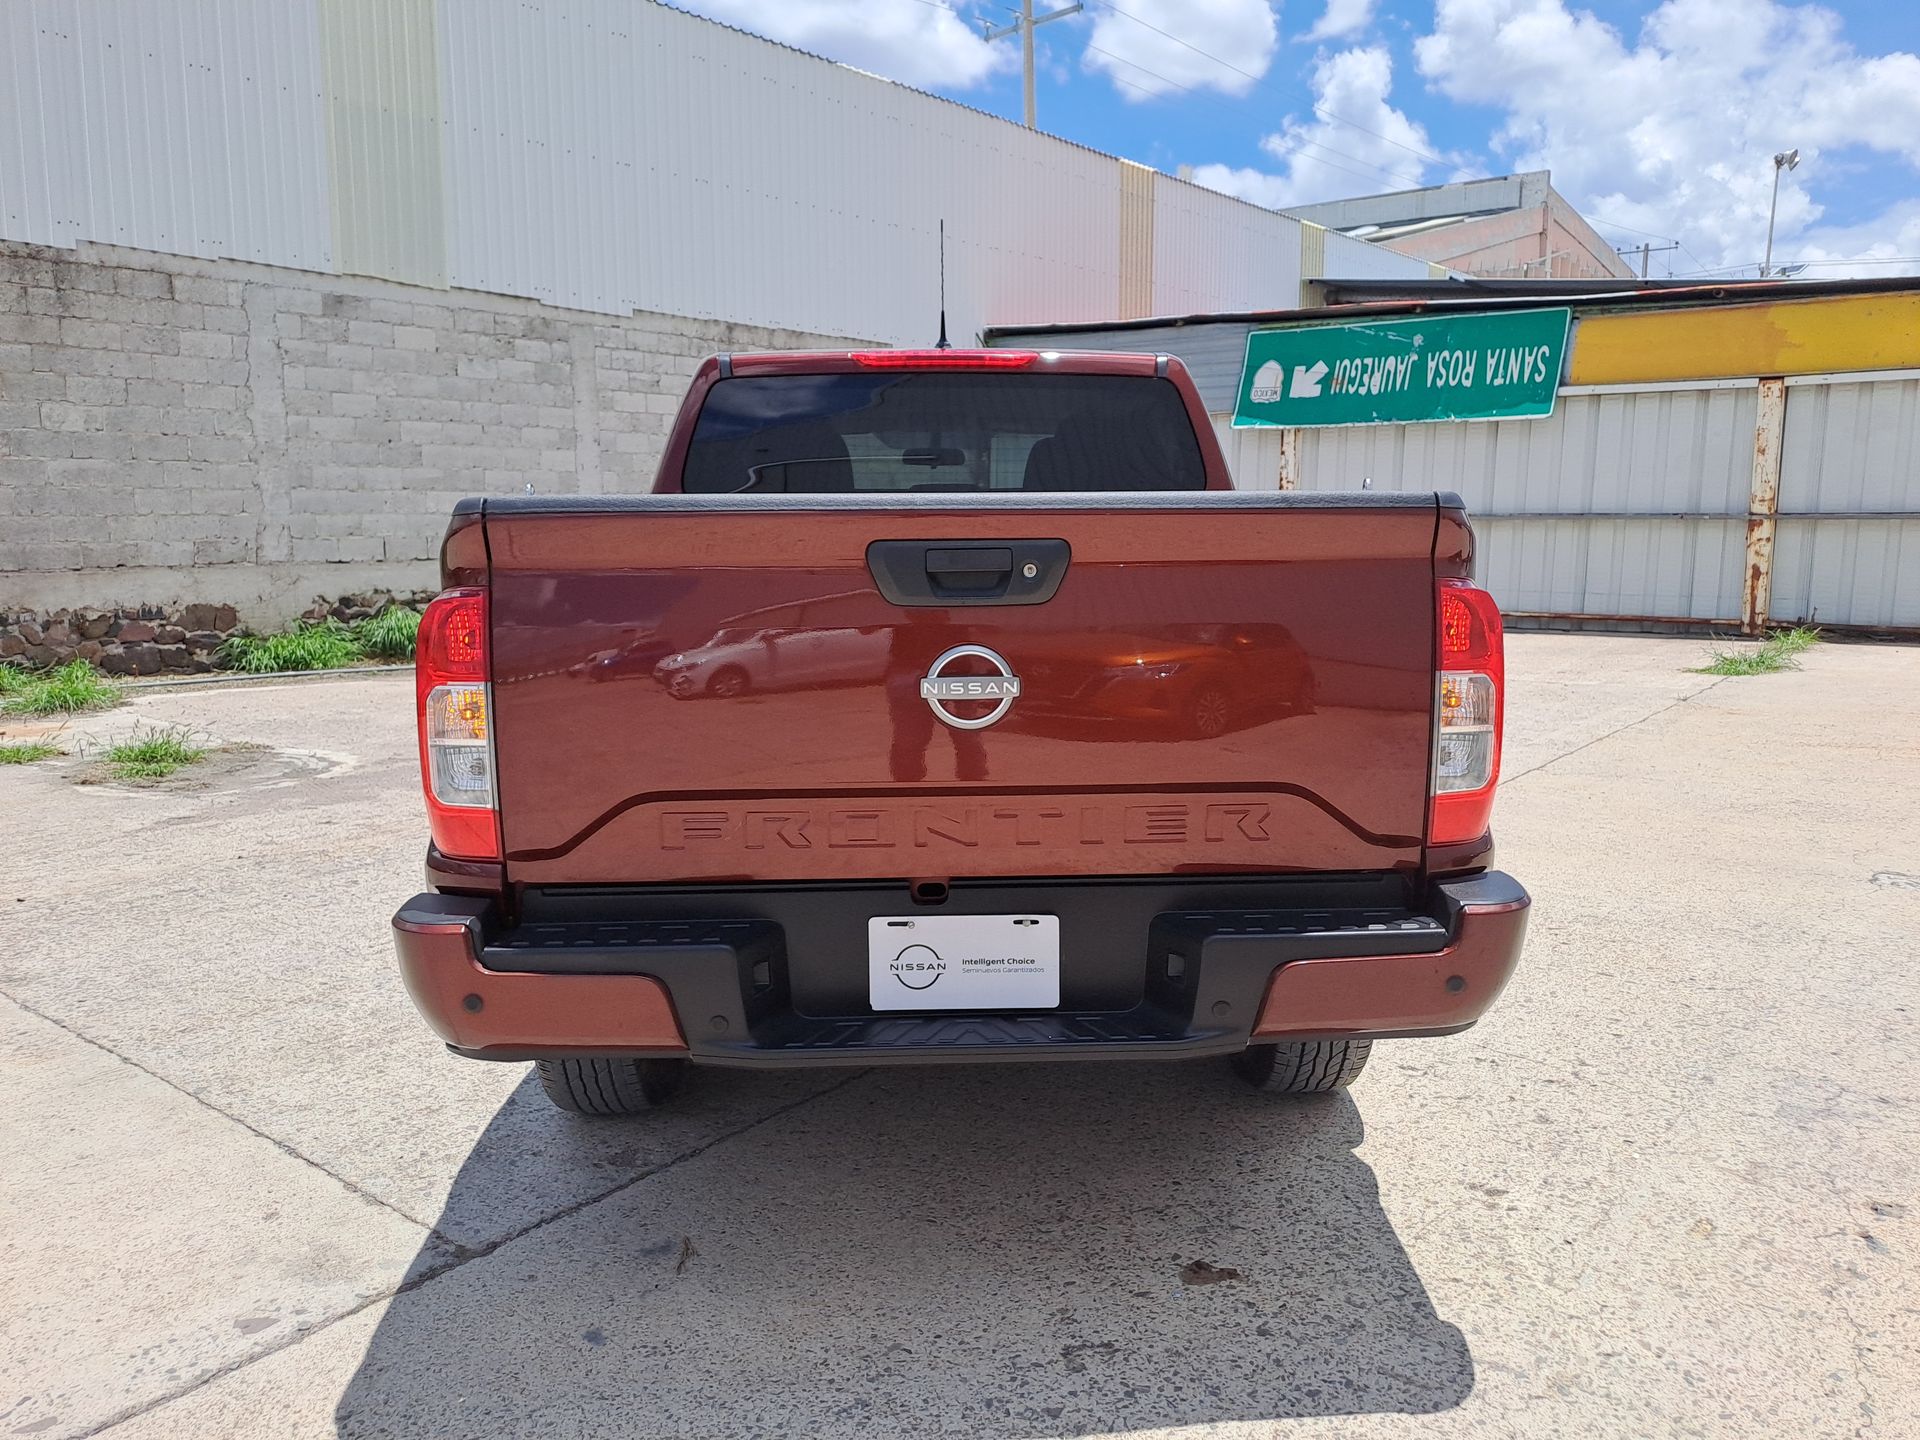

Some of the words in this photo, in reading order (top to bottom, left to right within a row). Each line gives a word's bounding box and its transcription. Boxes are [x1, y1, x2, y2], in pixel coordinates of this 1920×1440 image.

[1330, 354, 1417, 396] JAUREGUI
[1426, 350, 1477, 388] ROSA
[1486, 345, 1550, 385] SANTA
[1253, 389, 1278, 398] MEXICO
[923, 681, 1018, 694] NISSAN
[660, 803, 1271, 850] FRONTIER
[889, 963, 947, 971] NISSAN
[962, 958, 1005, 967] Intelligent
[1007, 957, 1036, 965] Choice
